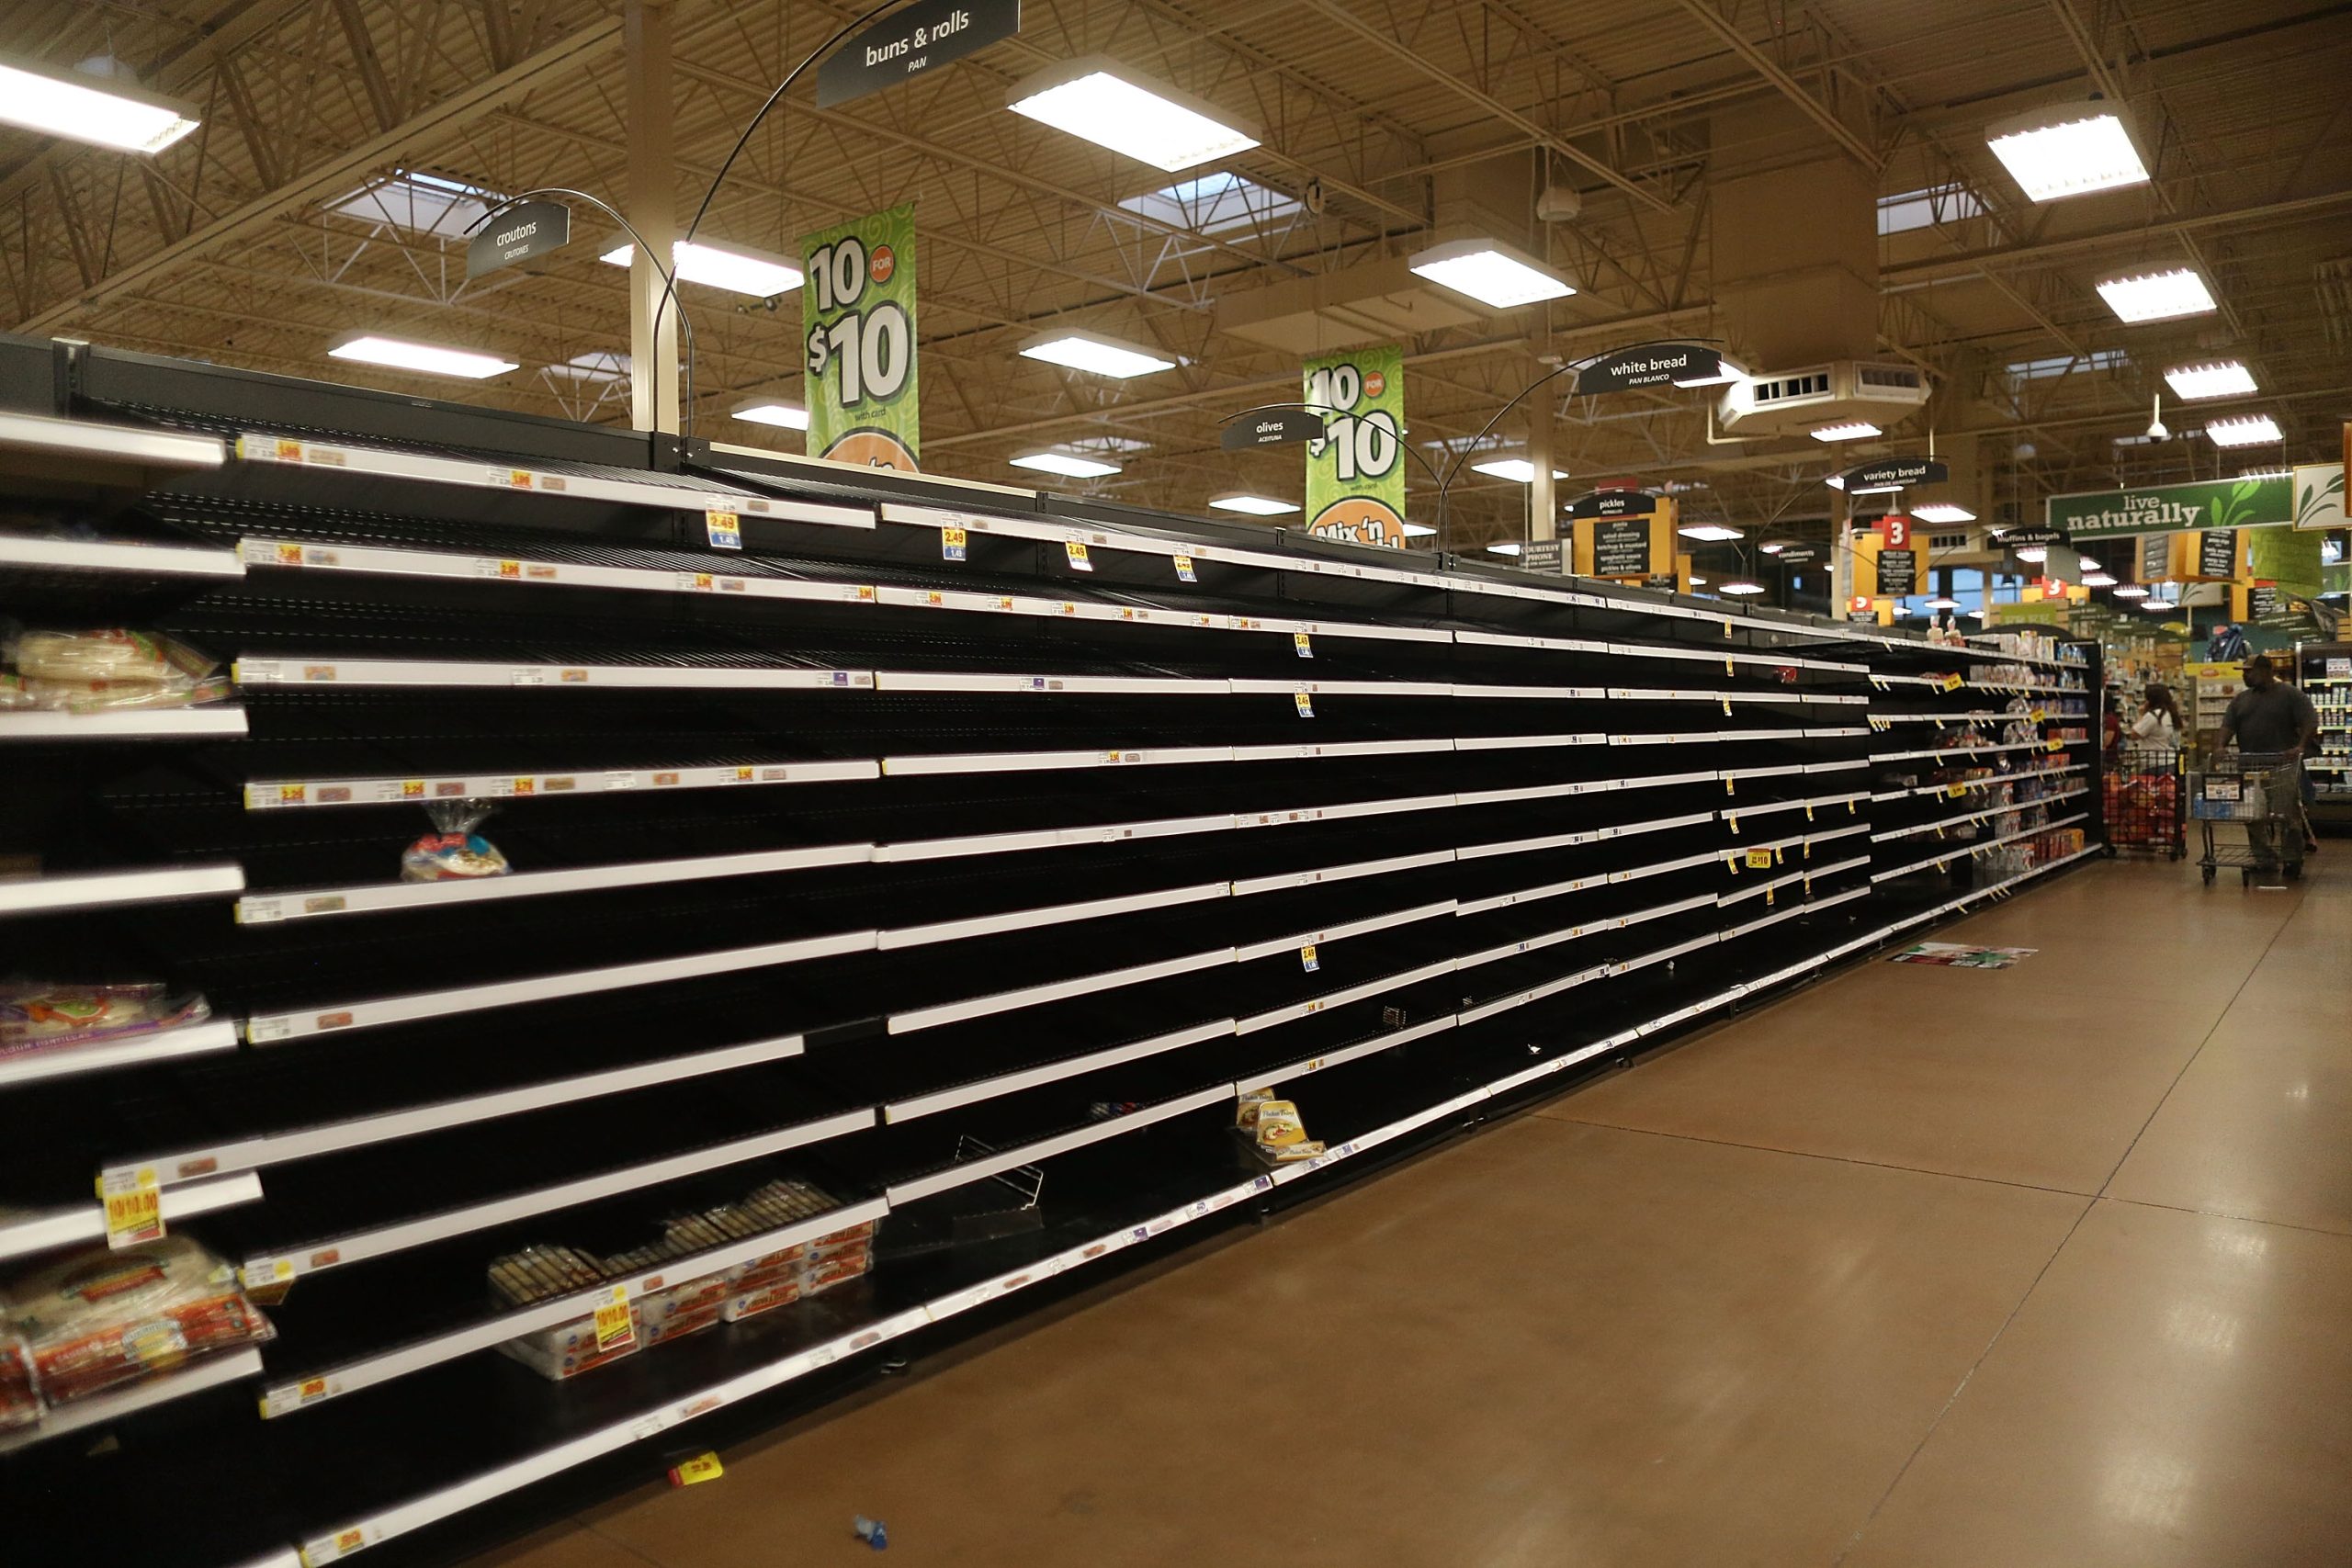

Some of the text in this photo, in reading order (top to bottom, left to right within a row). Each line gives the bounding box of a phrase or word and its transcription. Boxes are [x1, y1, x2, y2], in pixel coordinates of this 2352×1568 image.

[865, 9, 969, 66] buns & rolls
[908, 56, 927, 73] PAN
[497, 221, 537, 247] croutons
[809, 238, 891, 310] 10 FOR
[808, 304, 909, 404] $10
[1611, 355, 1687, 377] white bread
[1311, 365, 1382, 411] 10 FOR
[1629, 374, 1670, 385] PAN BLANCO
[854, 408, 887, 422] with card
[1256, 421, 1283, 434] olives
[1863, 465, 1927, 482] variety bread
[1600, 499, 1625, 511] pickles
[2124, 495, 2160, 511] live
[710, 516, 735, 530] 2.49
[2067, 502, 2200, 530] naturally
[945, 531, 964, 544] 2.49
[1315, 522, 1359, 543] Mix
[1891, 522, 1904, 545] 3
[2028, 534, 2034, 542] &
[2035, 532, 2060, 541] bagels
[1069, 546, 1085, 557] 2.49
[1296, 635, 1308, 645] 2.49
